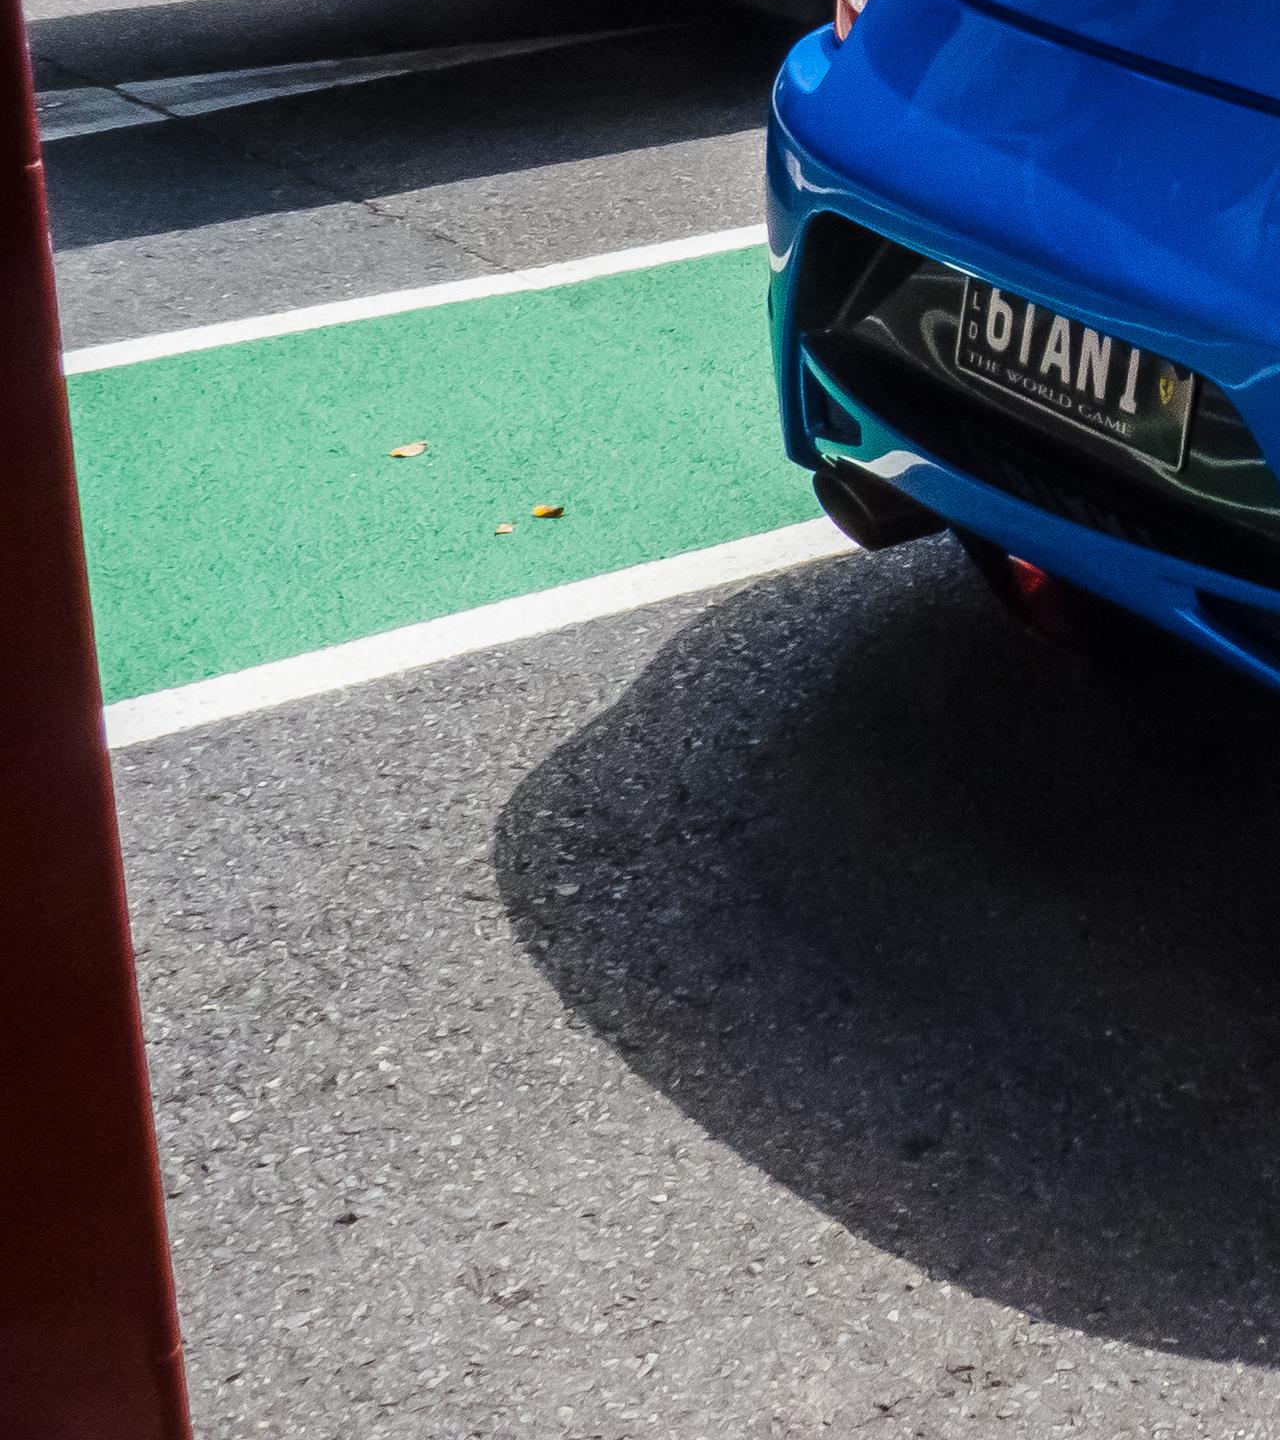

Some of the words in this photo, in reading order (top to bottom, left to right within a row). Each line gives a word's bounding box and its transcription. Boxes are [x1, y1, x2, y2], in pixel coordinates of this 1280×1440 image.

[968, 351, 1000, 376] THE
[1006, 369, 1073, 408] WORLD
[1078, 403, 1136, 439] GAME
